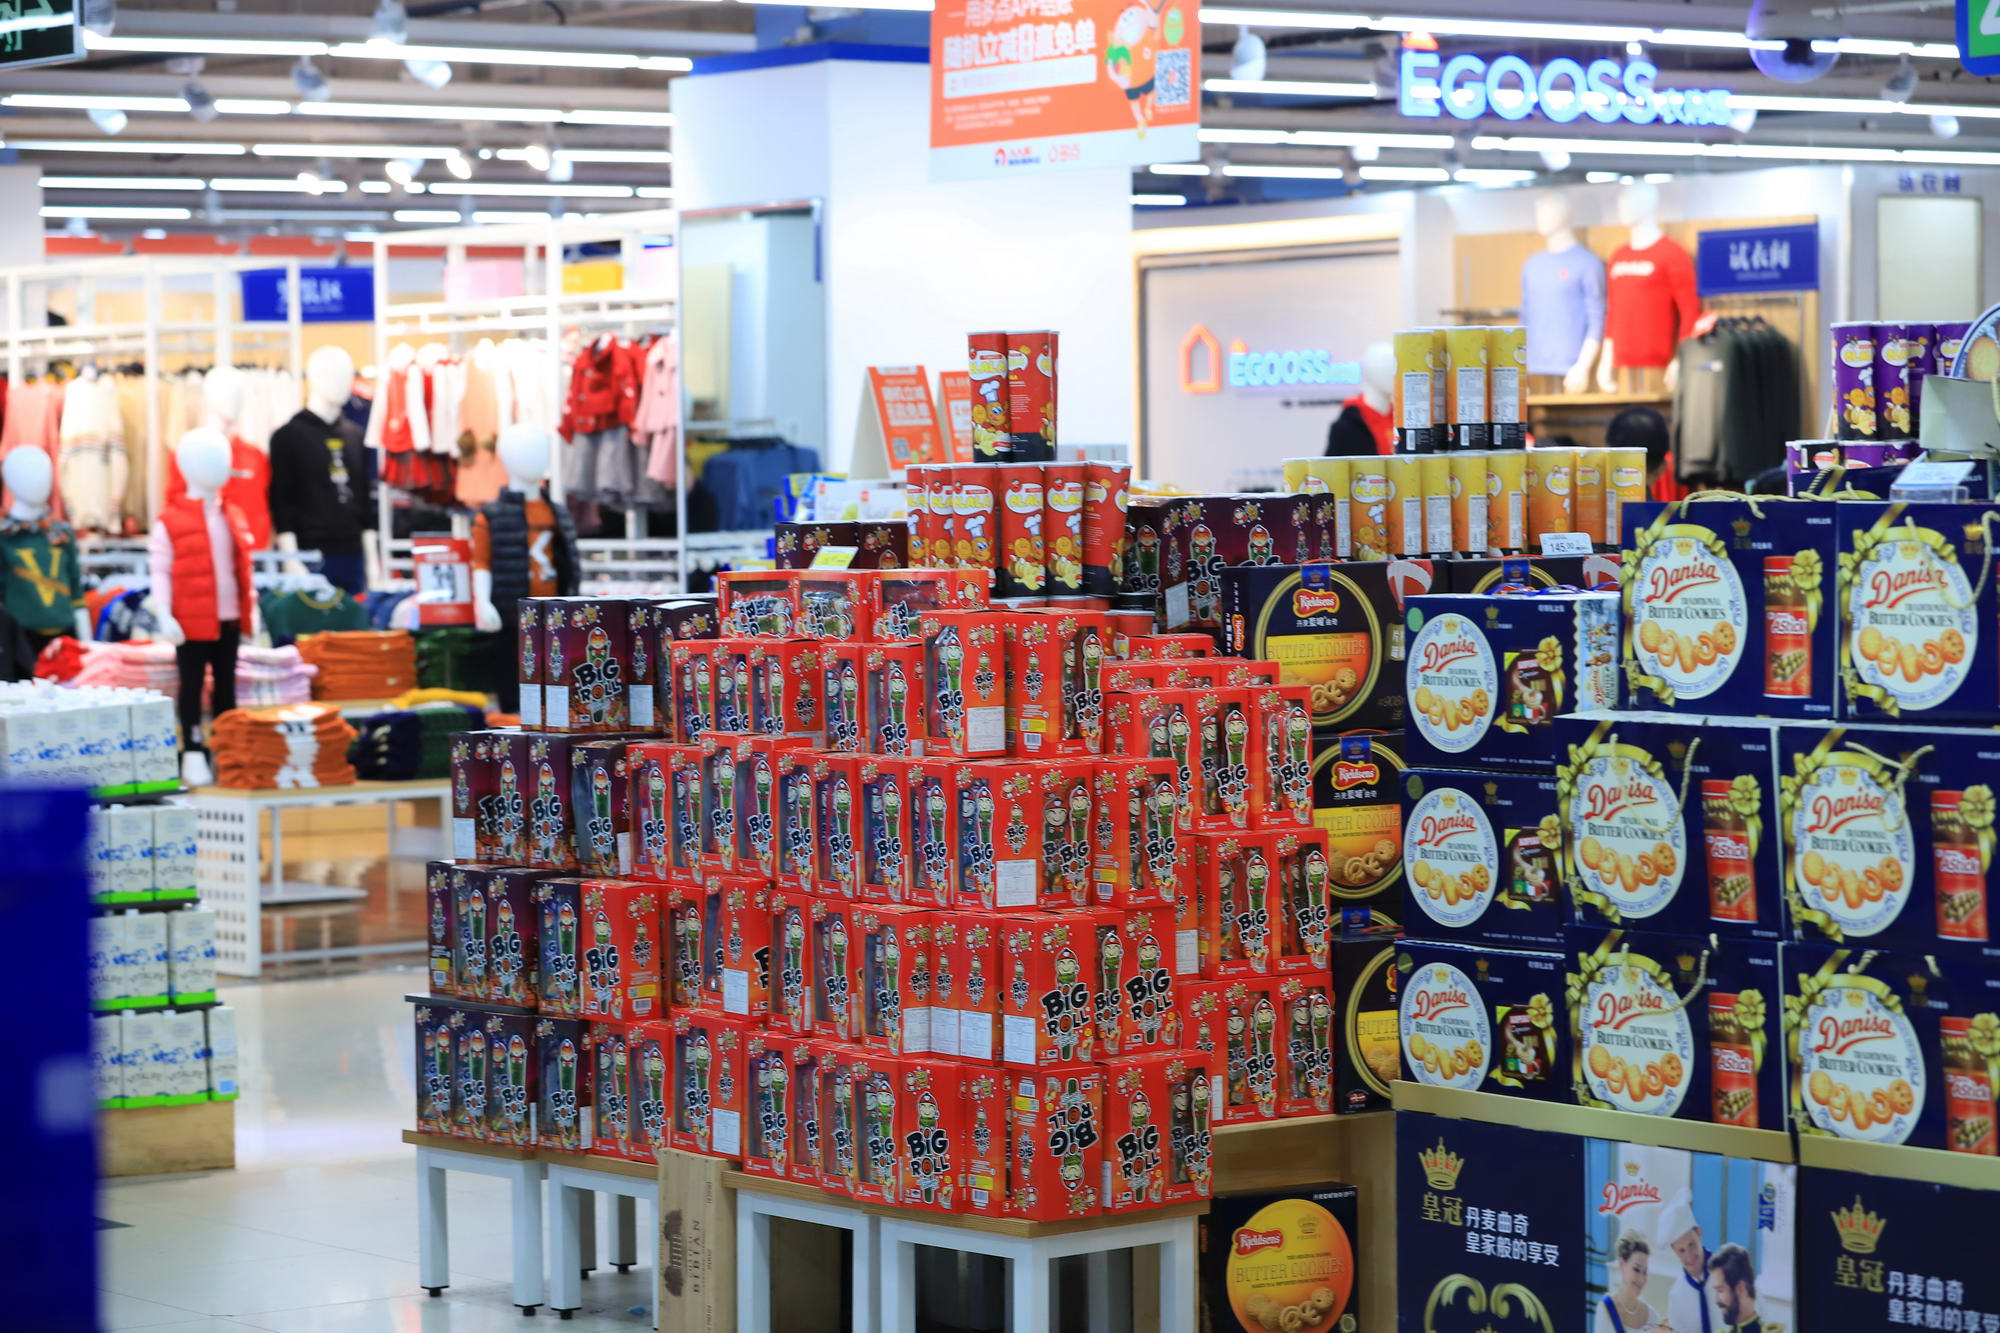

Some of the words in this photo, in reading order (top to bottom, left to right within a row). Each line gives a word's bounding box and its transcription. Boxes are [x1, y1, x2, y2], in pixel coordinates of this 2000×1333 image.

[1401, 51, 1658, 124] EGOOSS
[1730, 241, 1790, 270] 试衣间
[1230, 351, 1330, 386] EGOOSS
[1644, 556, 1721, 604] Danisa
[1865, 560, 1949, 609] Danisa
[1649, 605, 1685, 619] BUTTER
[1685, 606, 1726, 620] COOKIES
[1869, 611, 1906, 626] BUTTER
[1908, 613, 1955, 628] COOKIES
[1267, 643, 1314, 659] BUTTER
[1318, 639, 1366, 657] COOKIES
[1419, 635, 1478, 673] Danisa
[1422, 675, 1451, 687] BUTTER
[1451, 676, 1482, 687] COOKIES
[1358, 812, 1401, 829] COOKIE
[1807, 787, 1887, 834] Danisa
[1416, 809, 1478, 847] Danisa
[1588, 822, 1622, 838] BUTTER
[1623, 825, 1664, 841] COOKIES
[1420, 848, 1450, 861] BUTTER
[1450, 850, 1483, 863] COOKIES
[1811, 836, 1847, 852] BUTTER
[1850, 839, 1893, 855] COOKIES
[1130, 996, 1174, 1022] ROLL
[1411, 985, 1471, 1021] Danisa
[1045, 1010, 1091, 1037] ROLL
[1415, 1021, 1442, 1035] BUTTER
[1443, 1025, 1475, 1039] COOKIES
[1814, 1009, 1897, 1055] Danisa
[1597, 1031, 1631, 1048] BUTTER
[1632, 1034, 1673, 1051] COOKIES
[1818, 1056, 1855, 1073] BUTTER
[1857, 1059, 1903, 1077] COOKIES
[1048, 1102, 1095, 1131] ROLL
[909, 1154, 951, 1177] ROLL
[1121, 1153, 1161, 1179] ROLL
[1599, 1178, 1662, 1215] Danisa
[1421, 1192, 1463, 1226] 皇冠
[1465, 1206, 1529, 1236] 丹麦曲奇
[1240, 1233, 1281, 1249] Kjeldsens
[1465, 1231, 1560, 1267] 皇家般的享受
[1236, 1264, 1287, 1283] BUTTER
[1292, 1257, 1345, 1277] COOKIES
[1834, 1254, 1884, 1292] 皇冠
[1888, 1271, 1964, 1305] 丹麦曲奇
